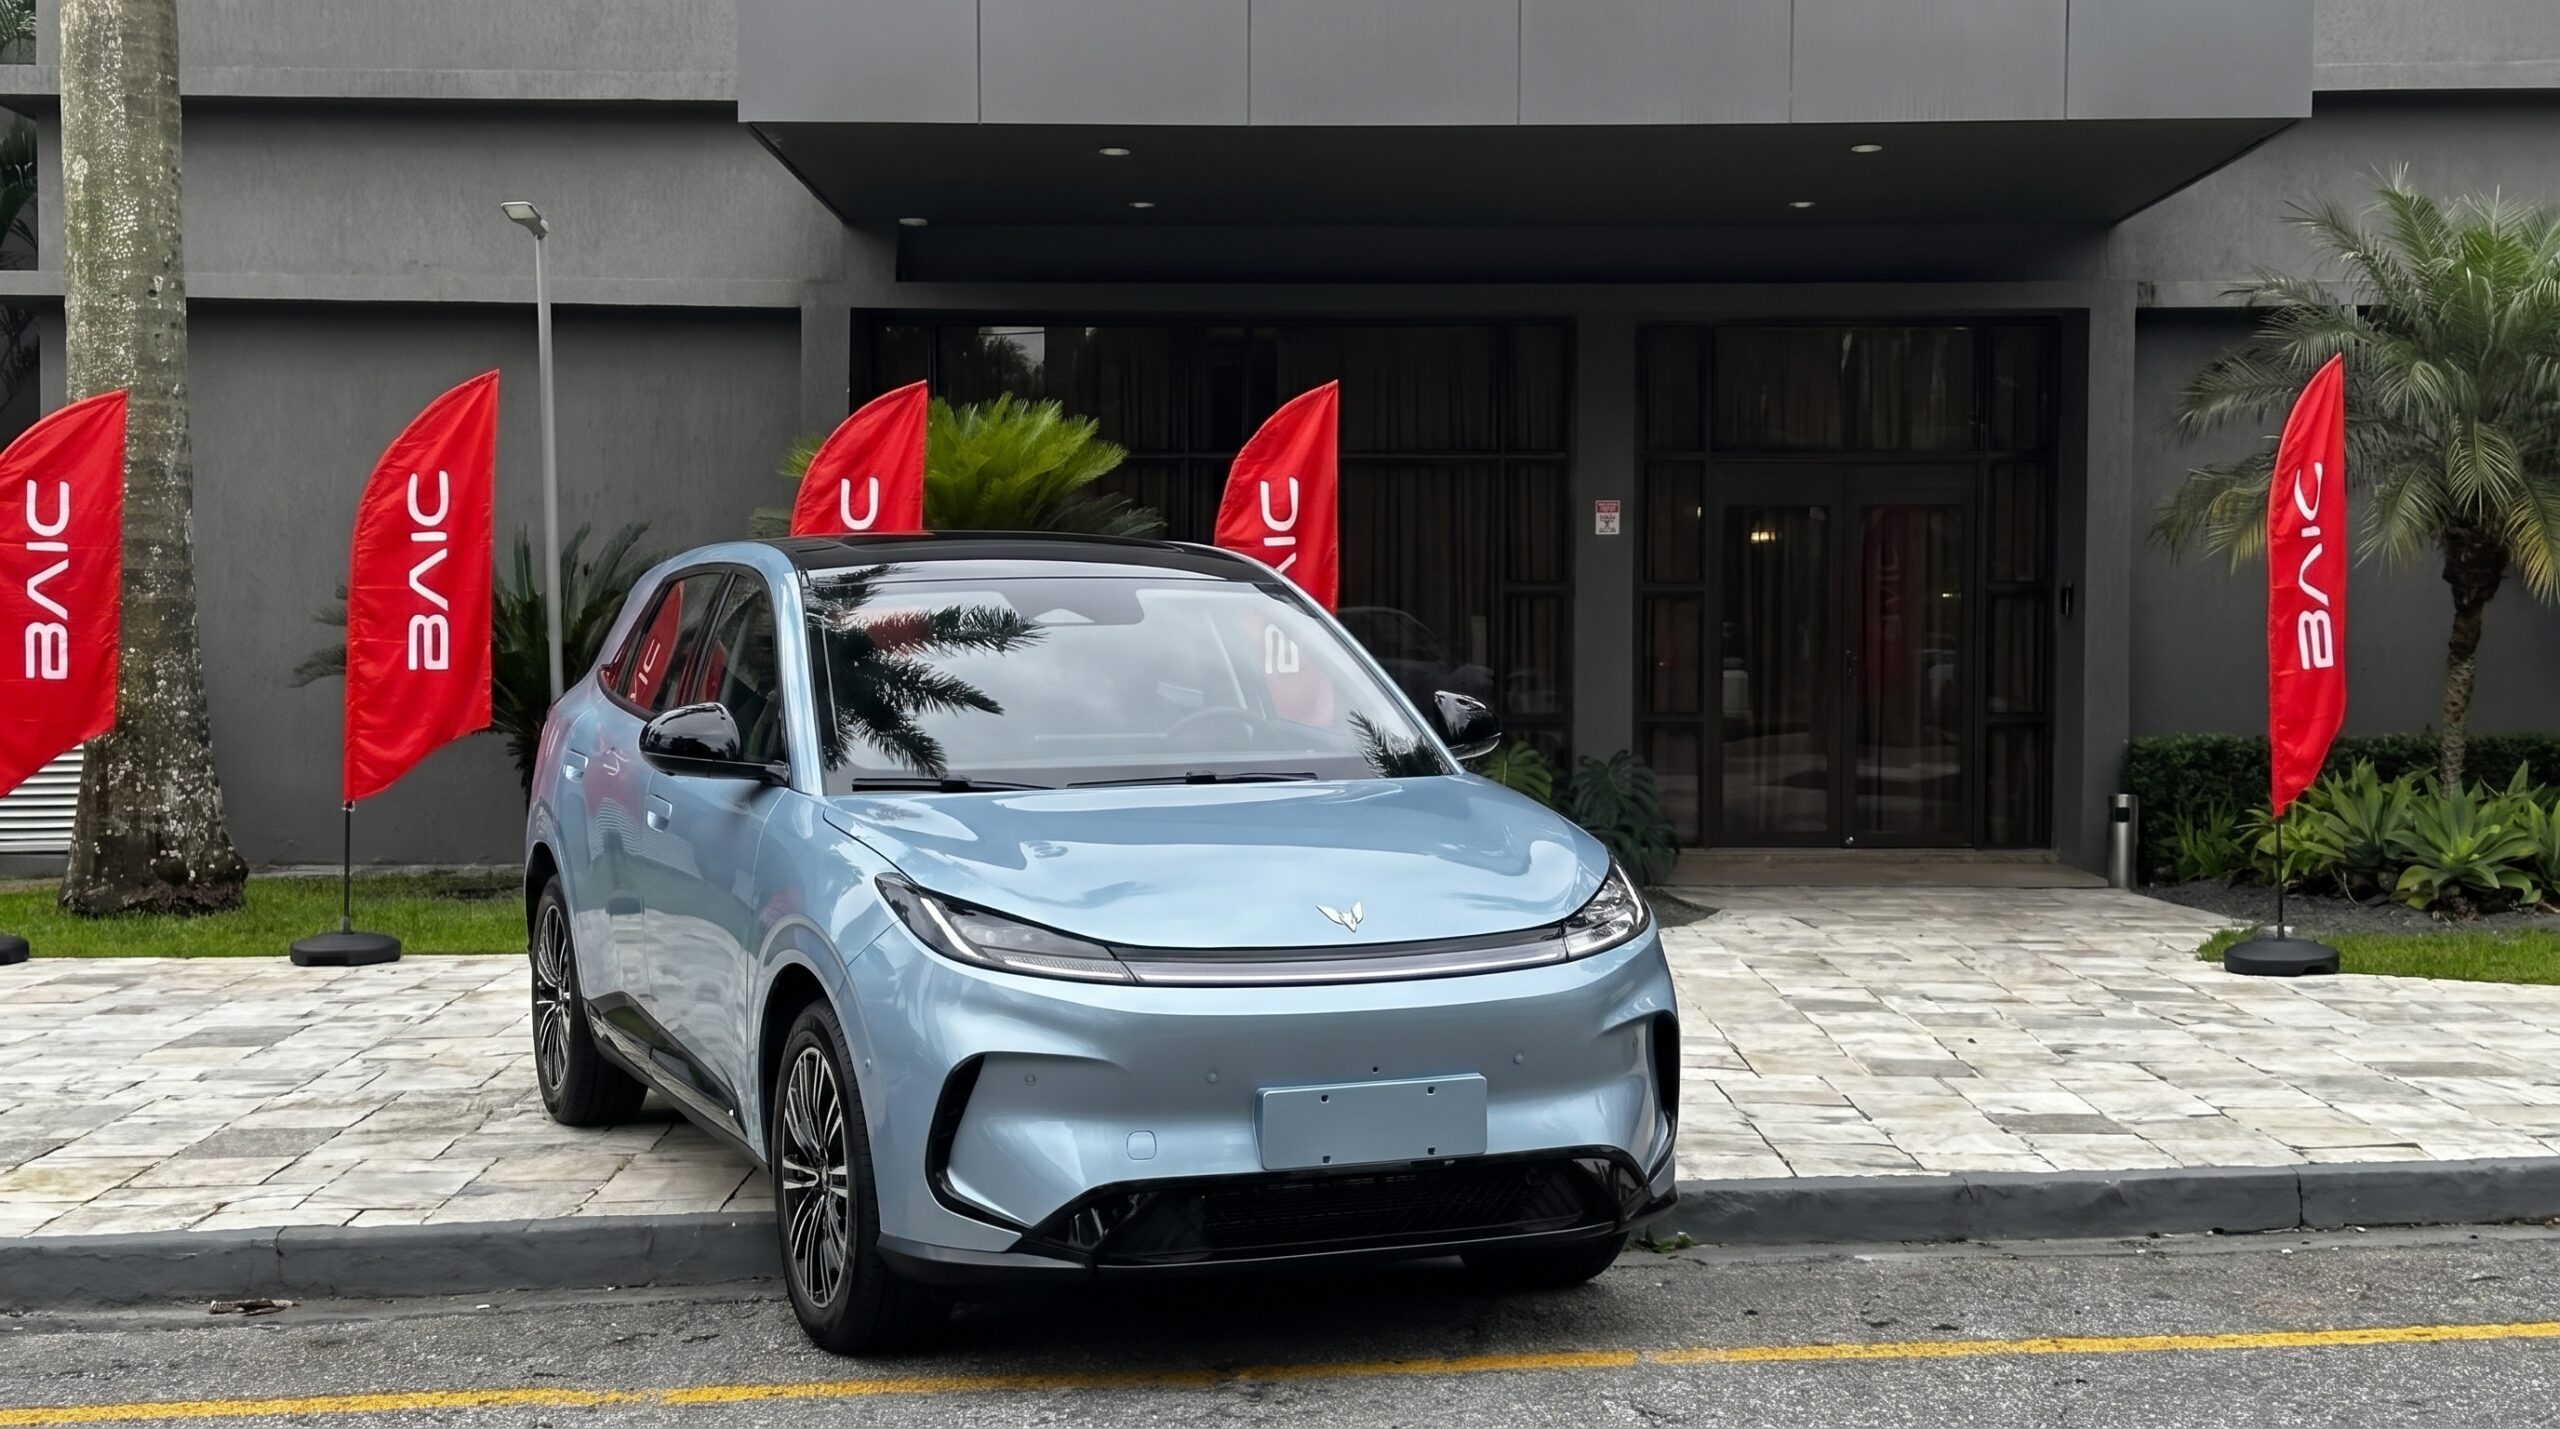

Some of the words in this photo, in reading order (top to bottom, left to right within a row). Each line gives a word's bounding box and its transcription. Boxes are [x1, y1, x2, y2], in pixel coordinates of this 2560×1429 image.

[26, 480, 70, 680] BAIC
[407, 470, 449, 671] BAIC
[2294, 462, 2334, 670] BAIC
